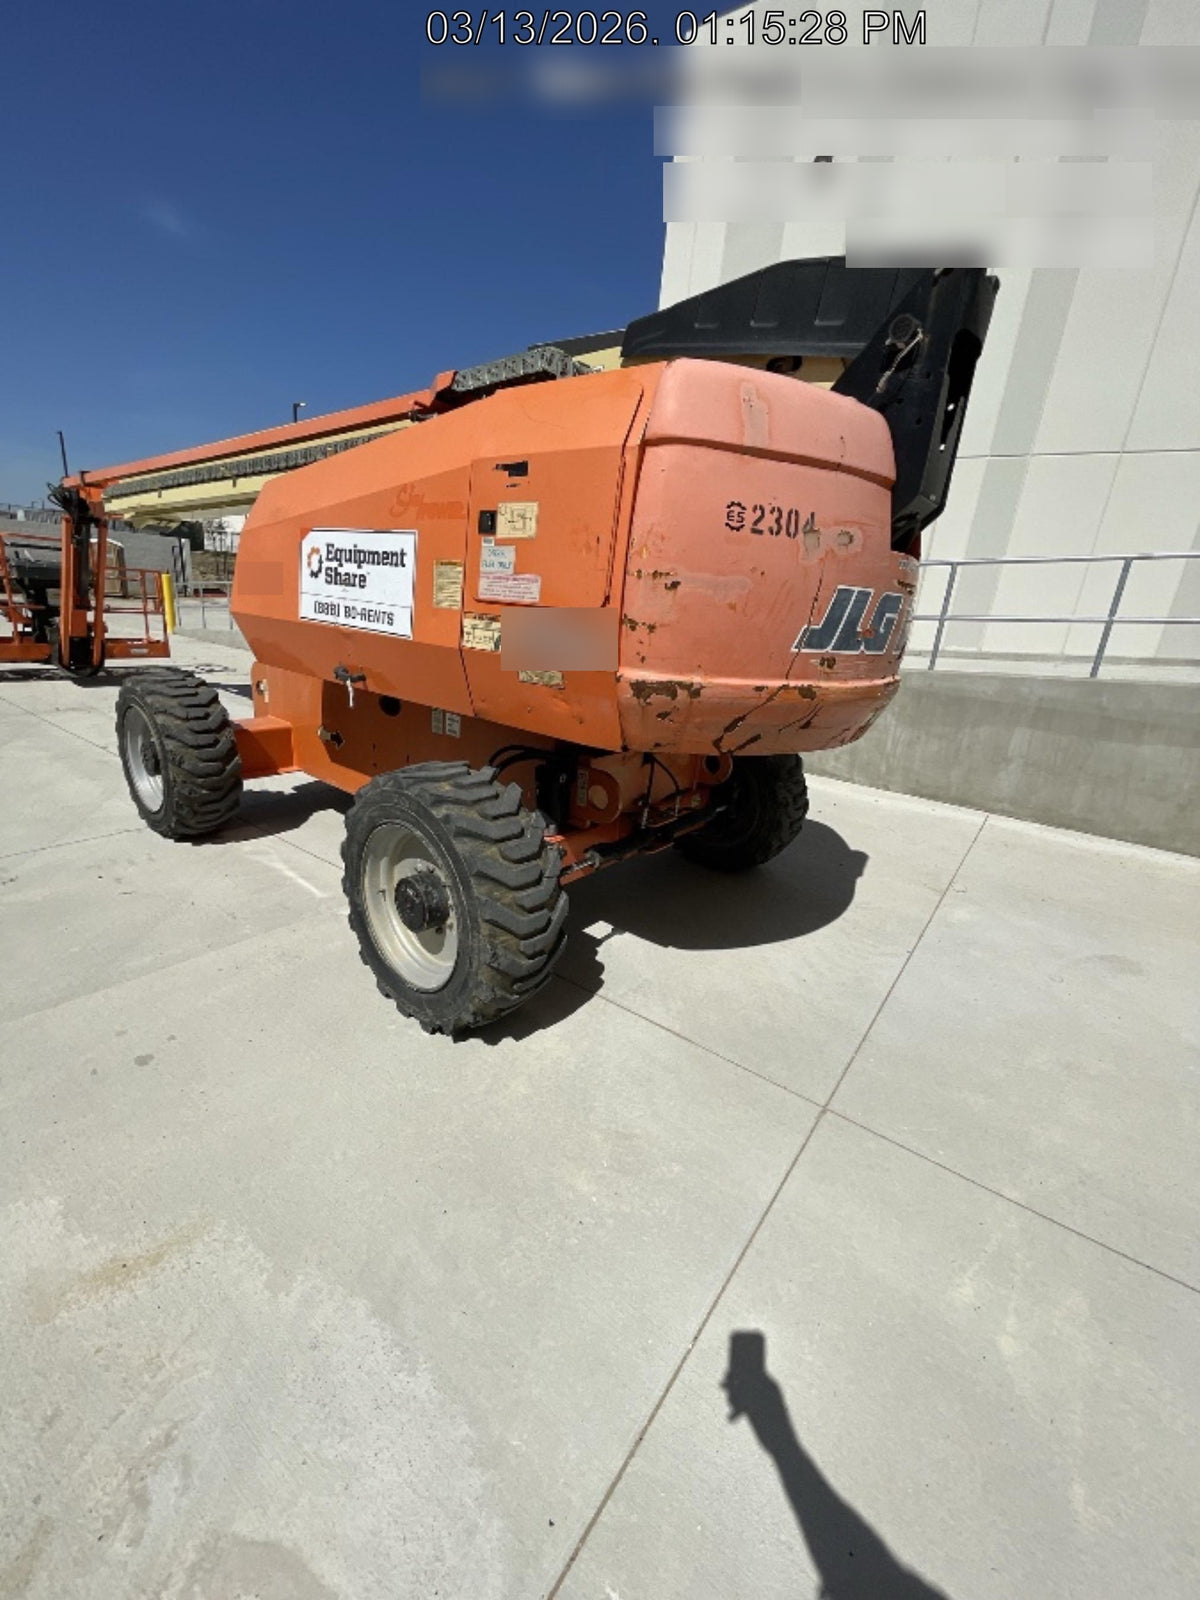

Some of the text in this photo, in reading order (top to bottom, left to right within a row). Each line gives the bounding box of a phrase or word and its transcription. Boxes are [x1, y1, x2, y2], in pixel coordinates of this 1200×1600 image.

[325, 543, 407, 569] Equipment
[324, 567, 367, 589] Share
[791, 585, 904, 654] JLG
